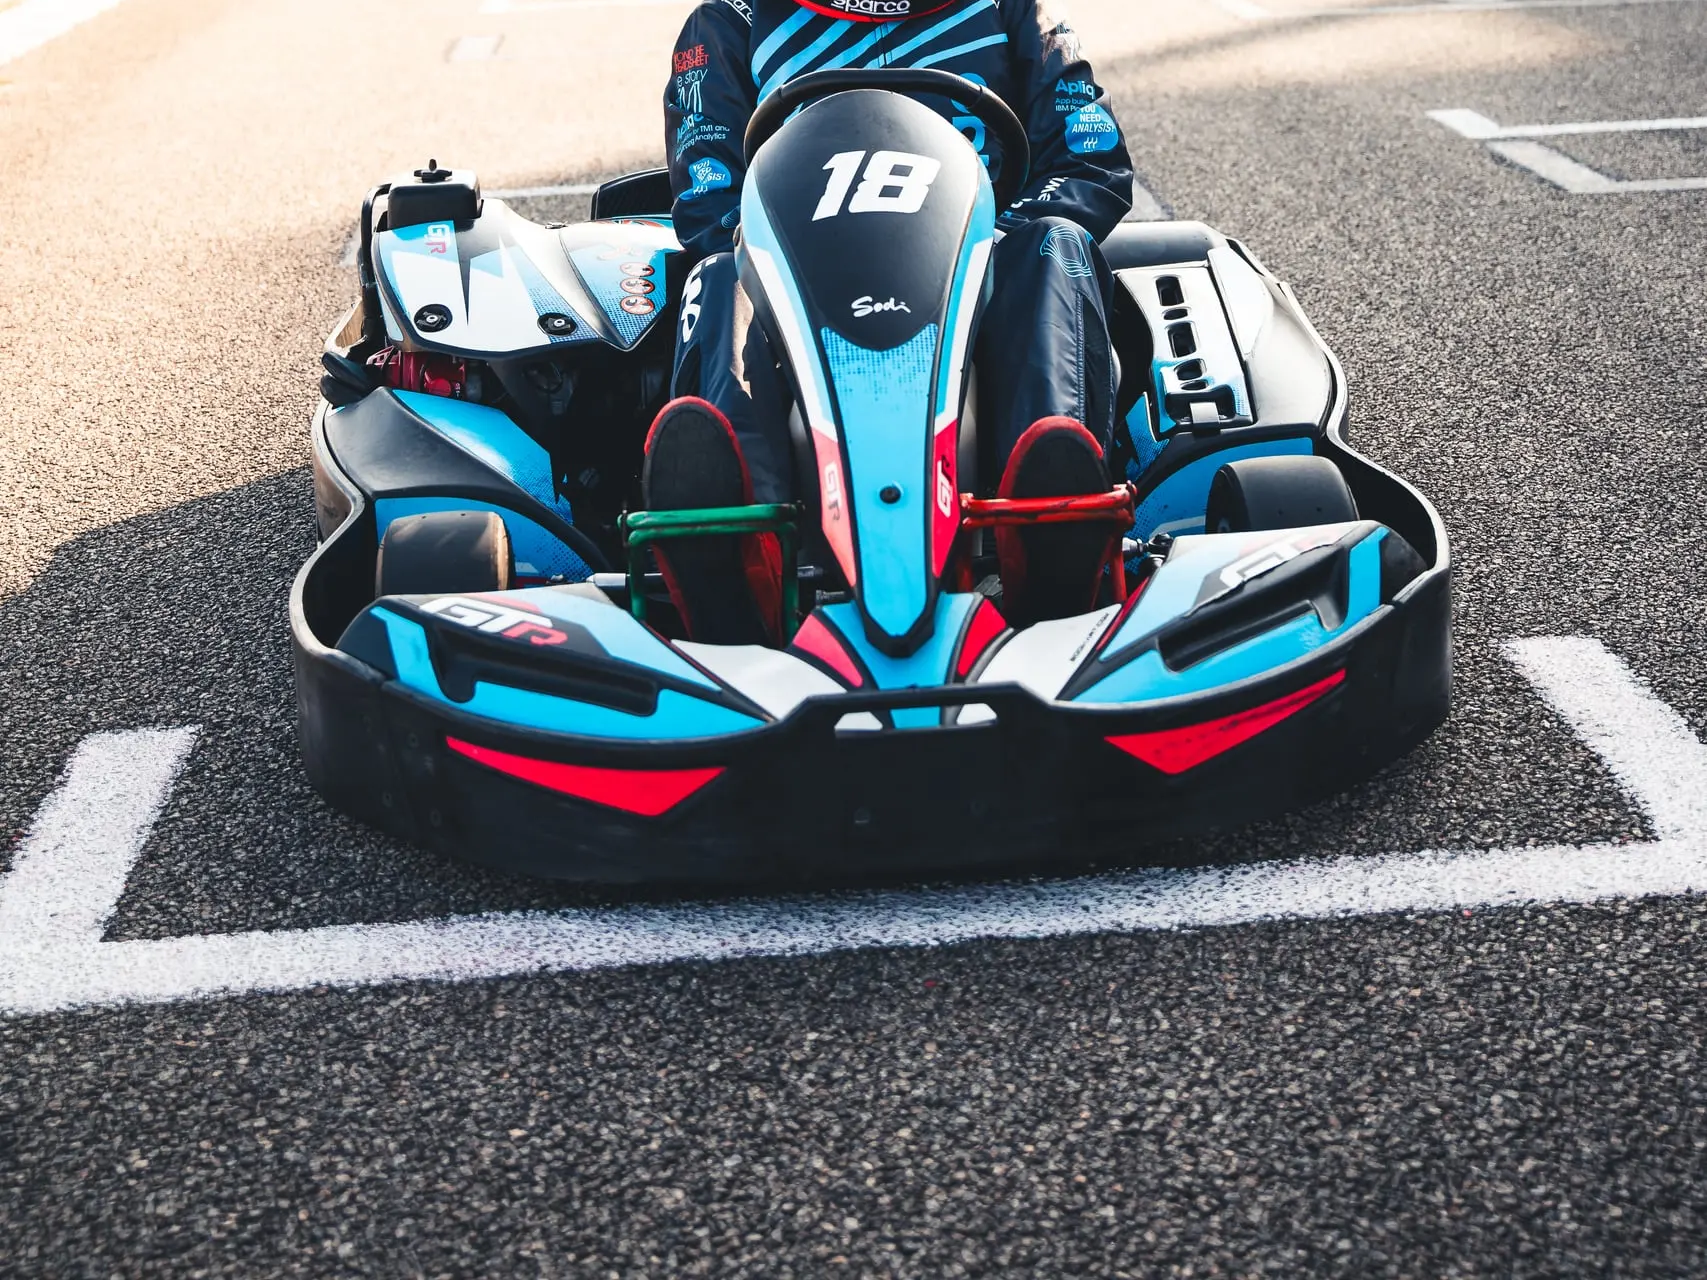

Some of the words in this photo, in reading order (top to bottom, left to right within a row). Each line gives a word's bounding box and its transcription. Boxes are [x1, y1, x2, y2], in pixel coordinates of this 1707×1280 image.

[684, 68, 709, 85] story
[1055, 78, 1096, 100] Apliq
[1080, 113, 1101, 123] NEED
[695, 132, 727, 142] Analytics
[1071, 122, 1115, 134] ANALYSIS!
[811, 150, 942, 222] 18
[851, 295, 912, 318] Sodi
[419, 596, 568, 645] GTR
